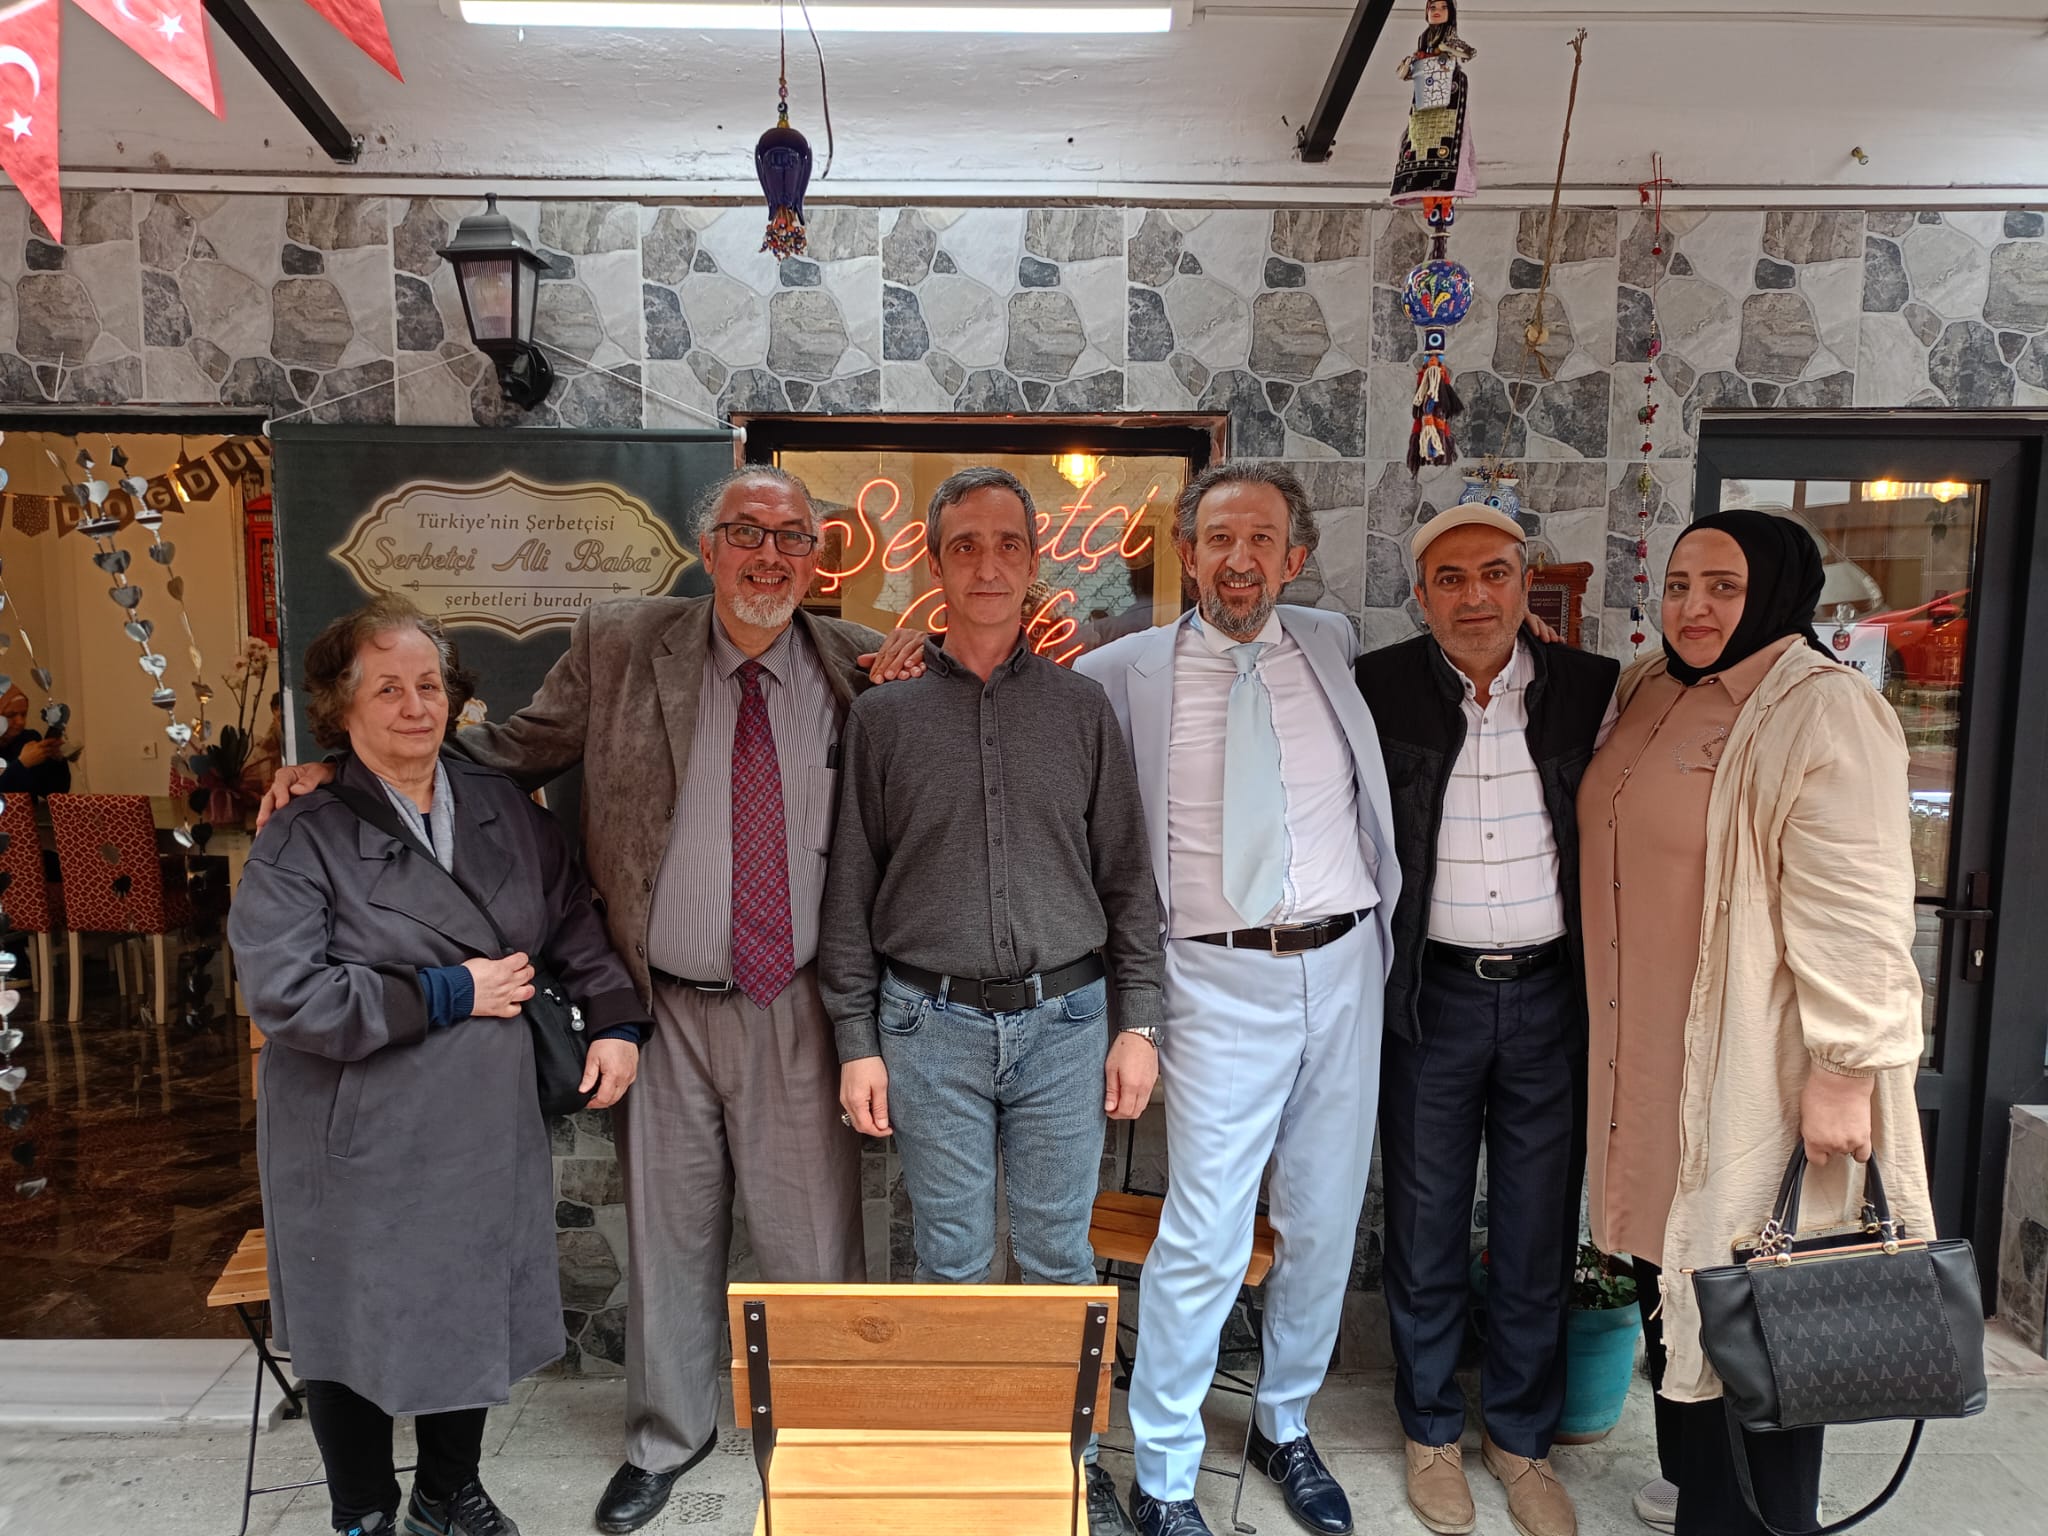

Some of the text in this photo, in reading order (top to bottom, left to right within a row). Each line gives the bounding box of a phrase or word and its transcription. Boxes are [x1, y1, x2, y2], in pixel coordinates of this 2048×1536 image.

[417, 512, 615, 534] Türkiye'nin Şerbetçisi
[367, 536, 478, 576] Şerbetçi
[491, 538, 551, 572] Ali
[445, 591, 527, 609] şerbetleri
